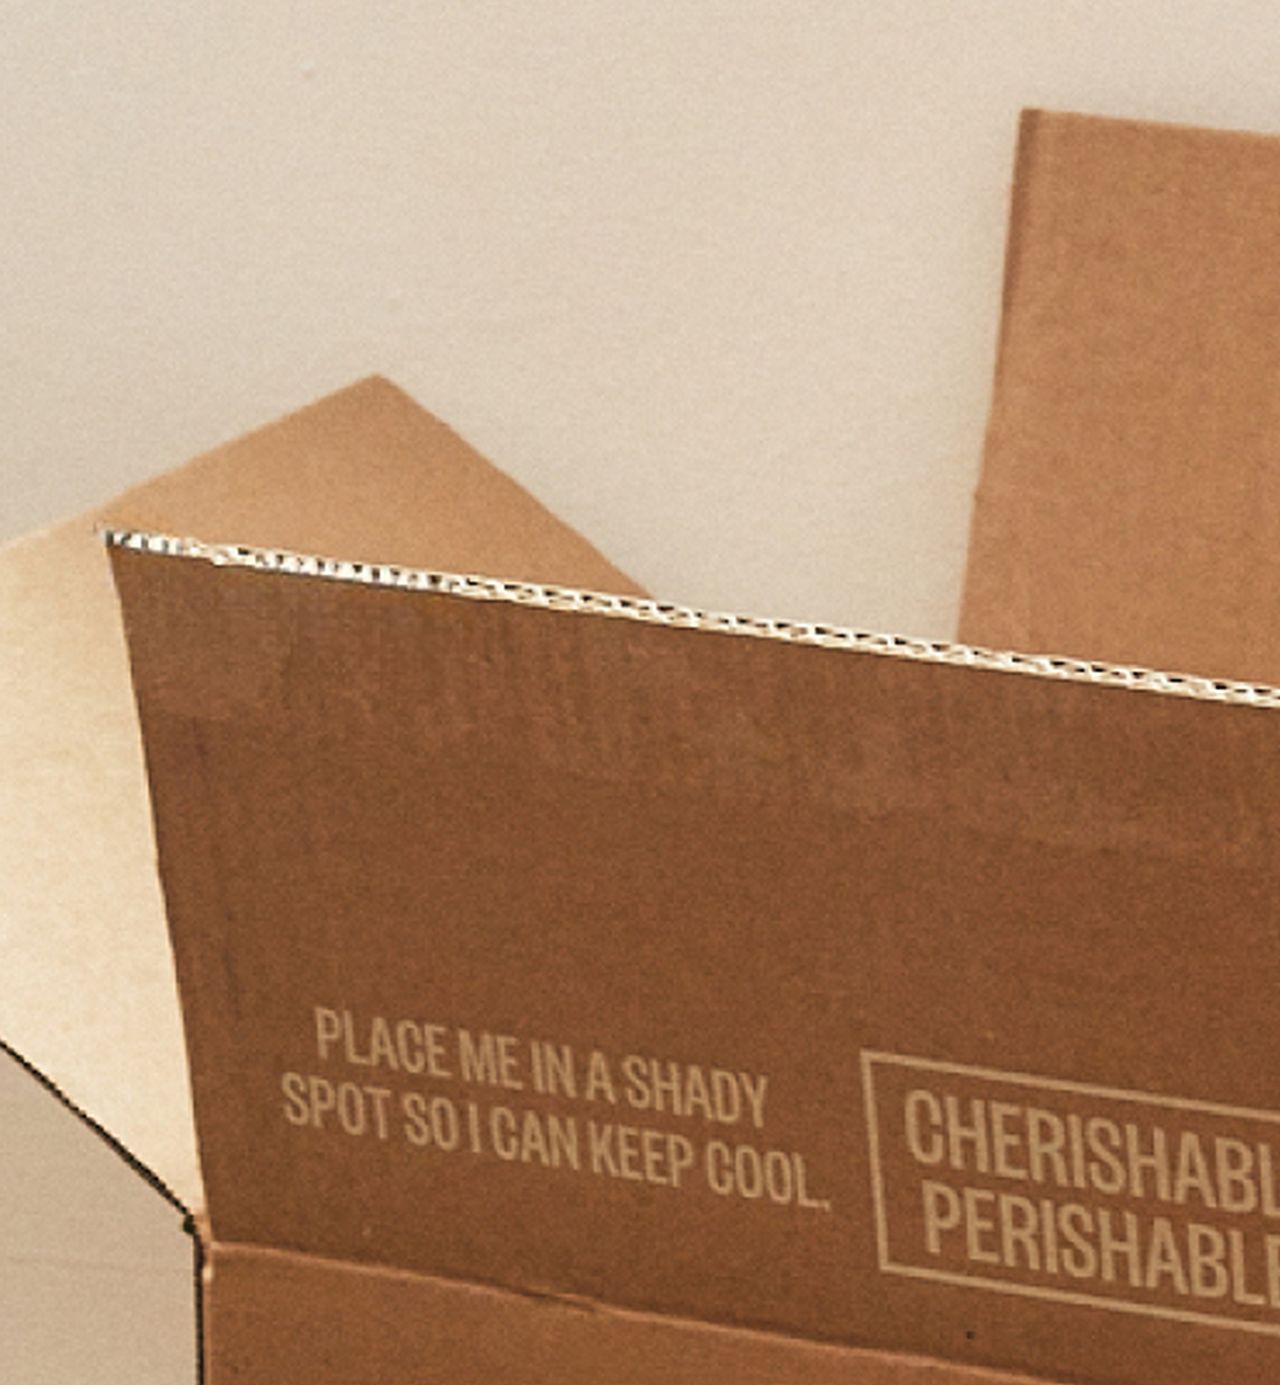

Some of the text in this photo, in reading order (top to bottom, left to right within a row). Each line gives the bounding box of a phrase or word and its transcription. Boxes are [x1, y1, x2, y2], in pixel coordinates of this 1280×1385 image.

[314, 1006, 768, 1129] PLACE ME IN A SHADY
[280, 1072, 831, 1212] SPOT SO I CAN KEEP COOL.
